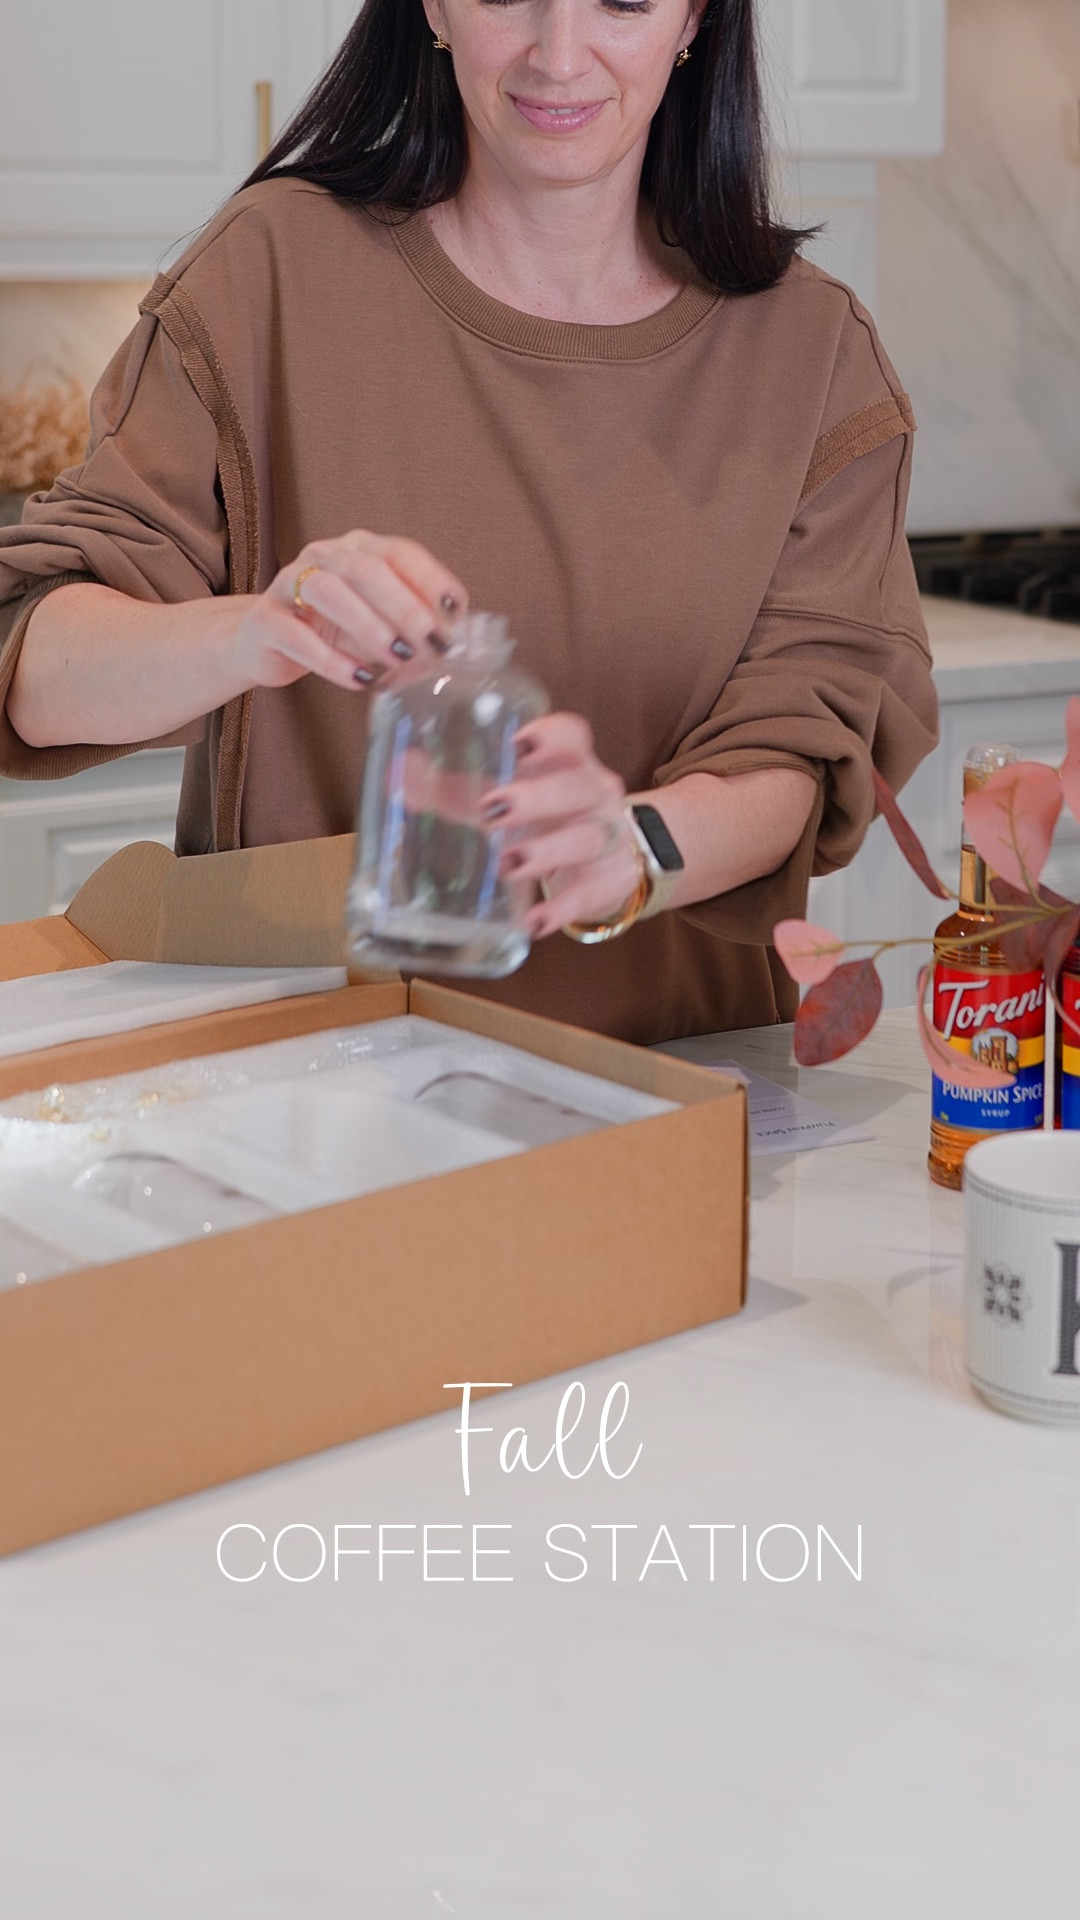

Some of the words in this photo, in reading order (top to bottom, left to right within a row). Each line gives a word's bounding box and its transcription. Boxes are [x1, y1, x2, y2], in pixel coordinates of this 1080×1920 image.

[938, 973, 1045, 1041] Torani
[942, 1080, 1009, 1104] PUMPKIN
[1012, 1082, 1043, 1104] SPICE
[980, 1108, 1011, 1118] SYRUP
